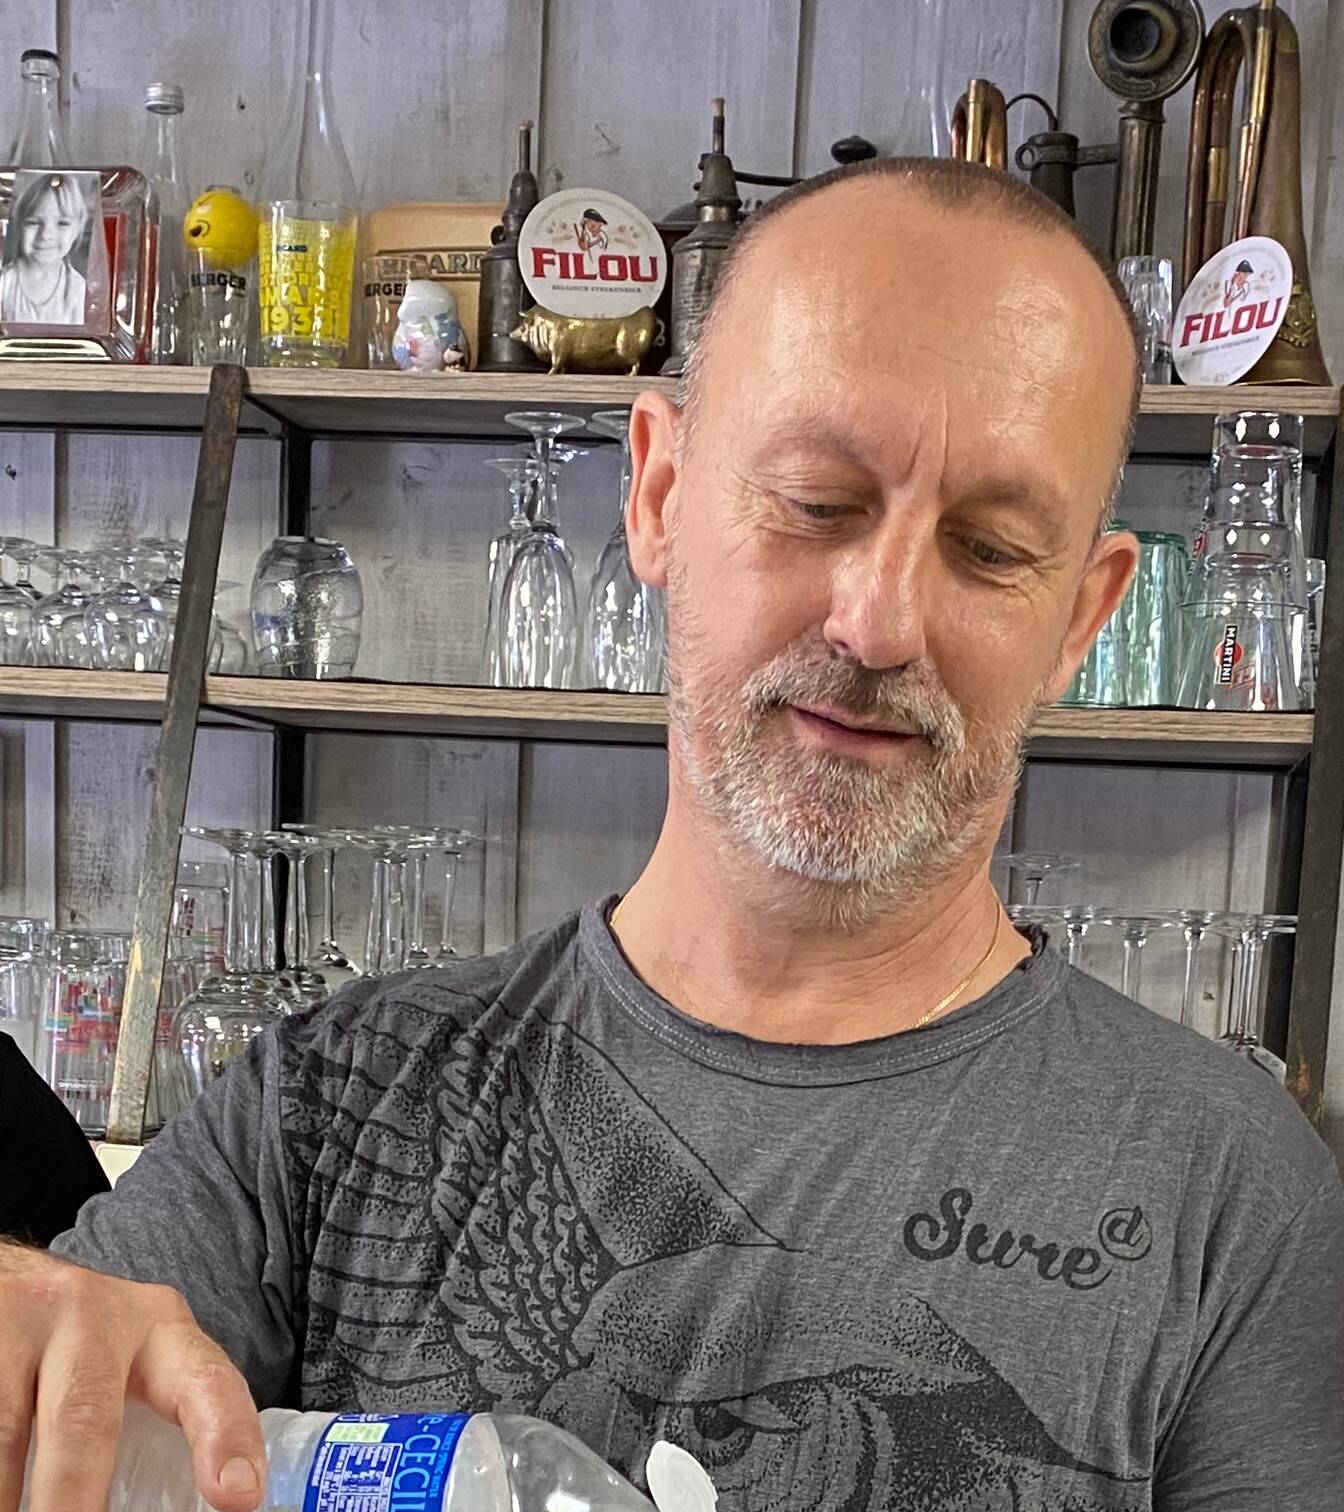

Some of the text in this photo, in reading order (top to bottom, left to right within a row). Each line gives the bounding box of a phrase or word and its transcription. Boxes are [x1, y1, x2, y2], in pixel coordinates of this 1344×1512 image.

[191, 273, 246, 291] BERGER
[531, 246, 659, 283] FILOU
[364, 282, 408, 297] ERGE
[1179, 296, 1285, 349] FILOU
[1220, 626, 1238, 683] MARTINI
